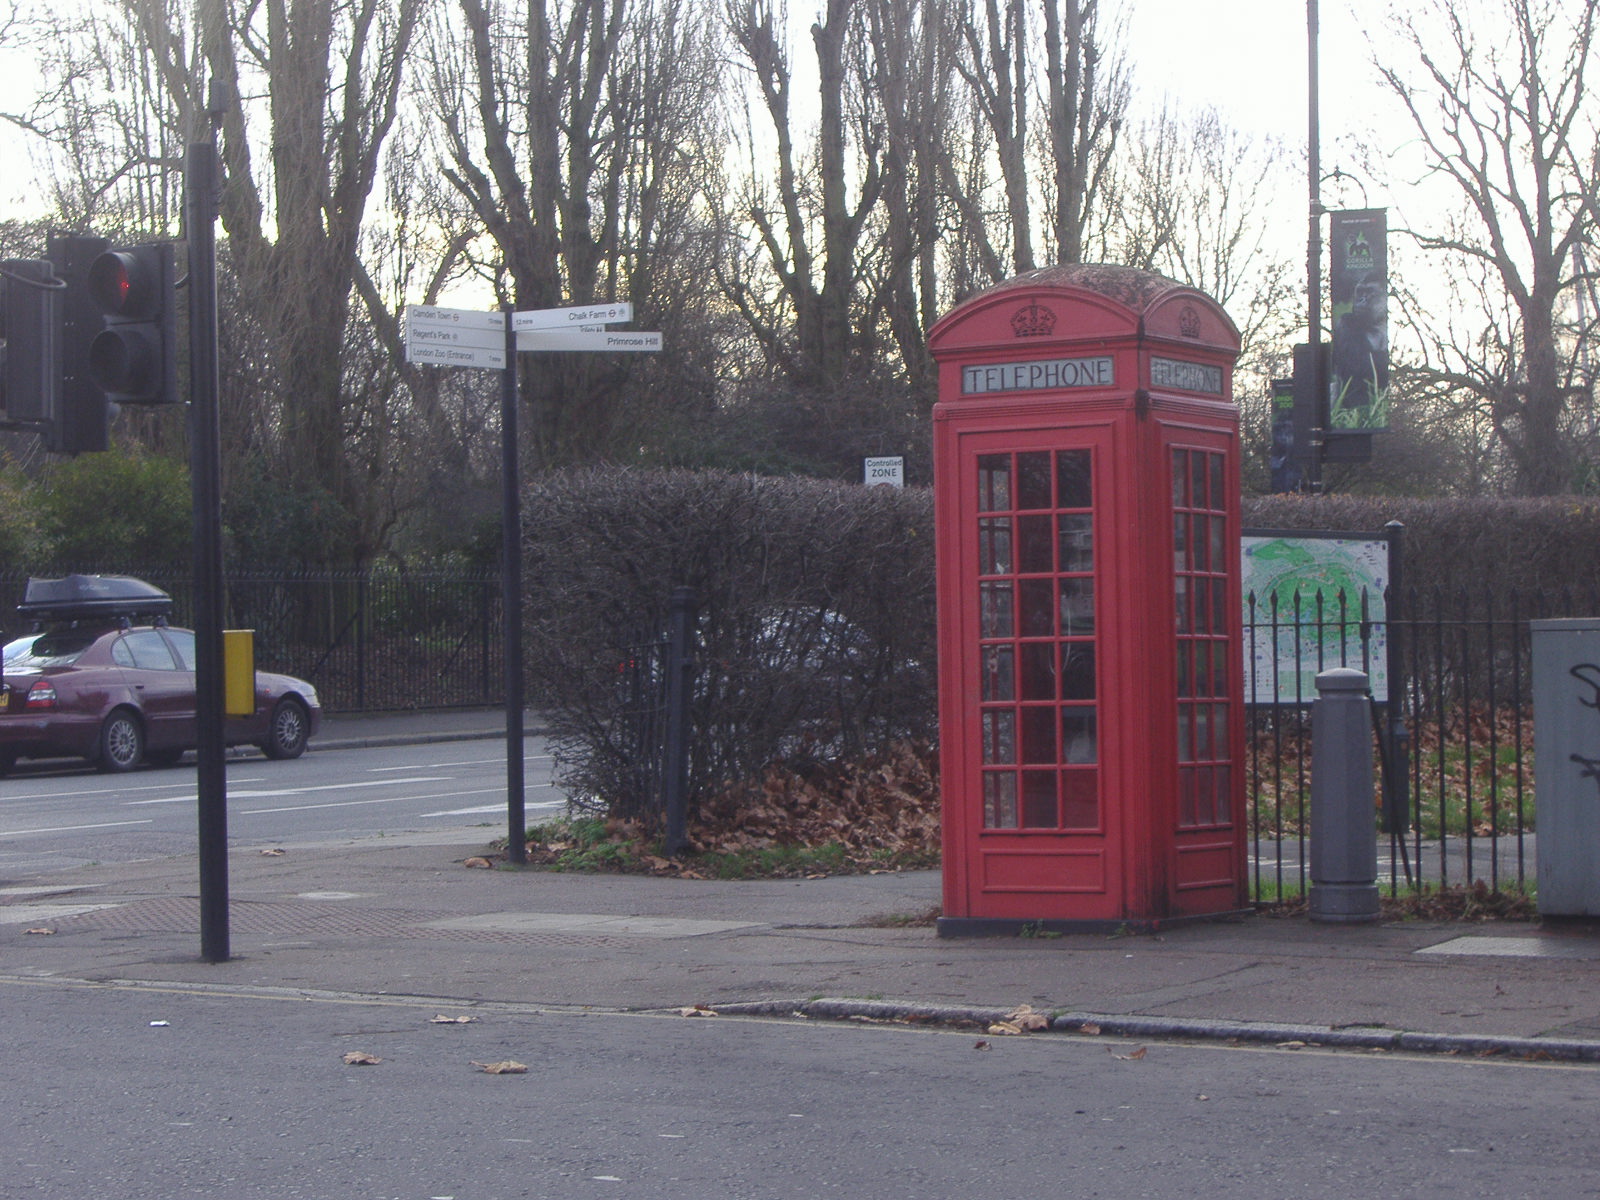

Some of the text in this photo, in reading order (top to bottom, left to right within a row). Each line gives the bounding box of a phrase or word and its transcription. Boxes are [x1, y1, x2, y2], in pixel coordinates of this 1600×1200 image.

[437, 311, 451, 320] Town
[568, 310, 607, 321] Chalk Farm
[412, 328, 450, 340] Regent's Park
[607, 337, 658, 346] Primrose Hill
[413, 348, 434, 357] London
[435, 349, 446, 358] Zoo
[967, 360, 1111, 392] TELEPHONE
[1151, 360, 1221, 392] TELEPHONE
[871, 468, 897, 477] ZONE
